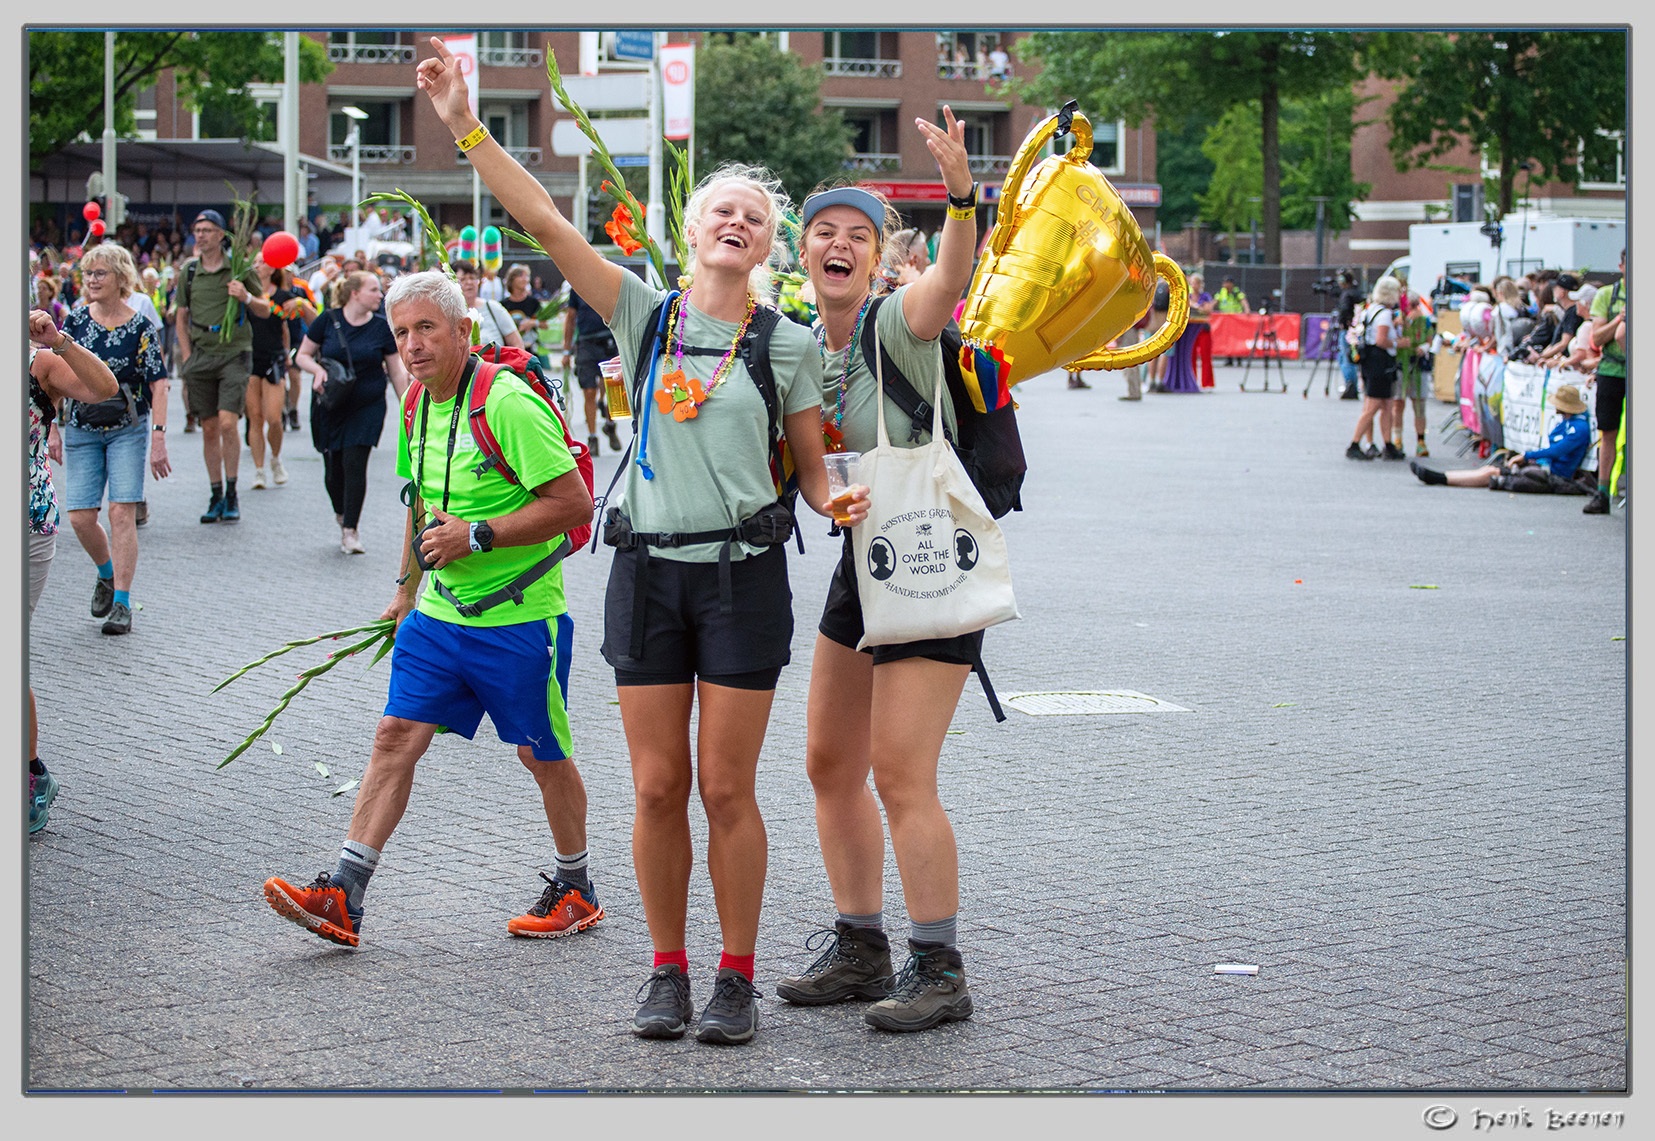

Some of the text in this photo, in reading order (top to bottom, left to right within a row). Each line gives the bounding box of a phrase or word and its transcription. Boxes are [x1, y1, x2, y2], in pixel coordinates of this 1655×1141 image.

[451, 405, 461, 429] Canon
[880, 509, 927, 533] SØSTRENE
[917, 540, 934, 551] ALL
[902, 549, 949, 564] OVER THE
[909, 563, 946, 575] WORLD
[884, 572, 967, 599] HANDELSKOMPAGNIE
